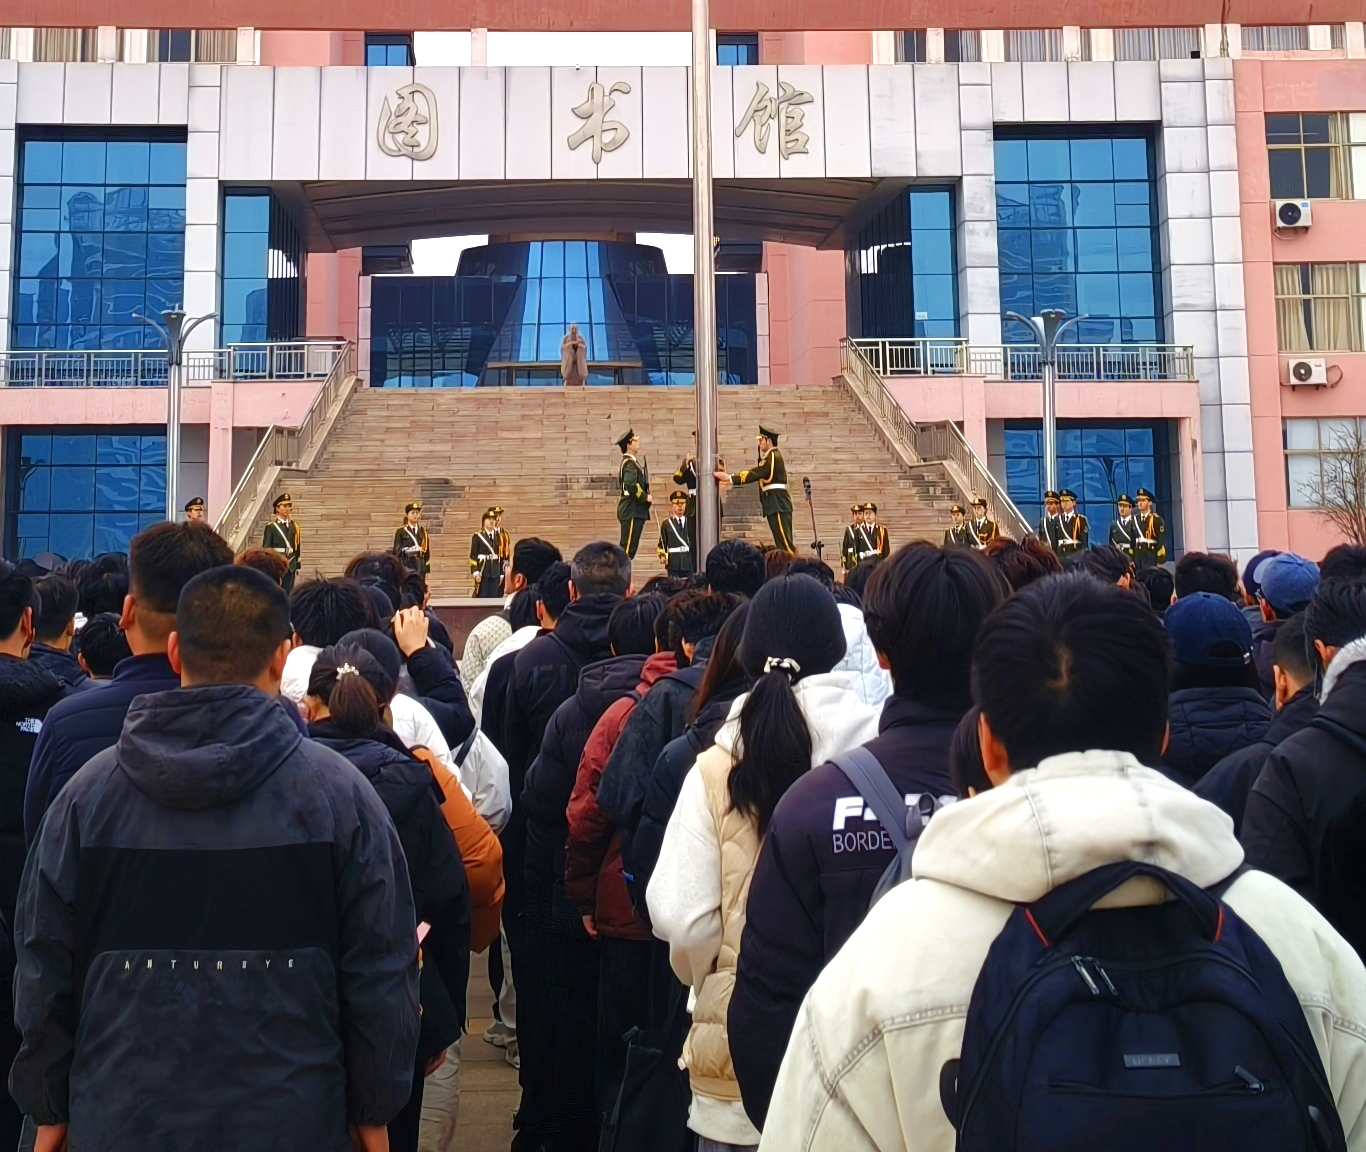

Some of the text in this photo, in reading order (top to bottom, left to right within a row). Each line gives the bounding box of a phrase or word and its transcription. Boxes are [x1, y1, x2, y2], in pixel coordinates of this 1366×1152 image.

[377, 81, 814, 164] 图书馆
[833, 830, 895, 854] BORDE
